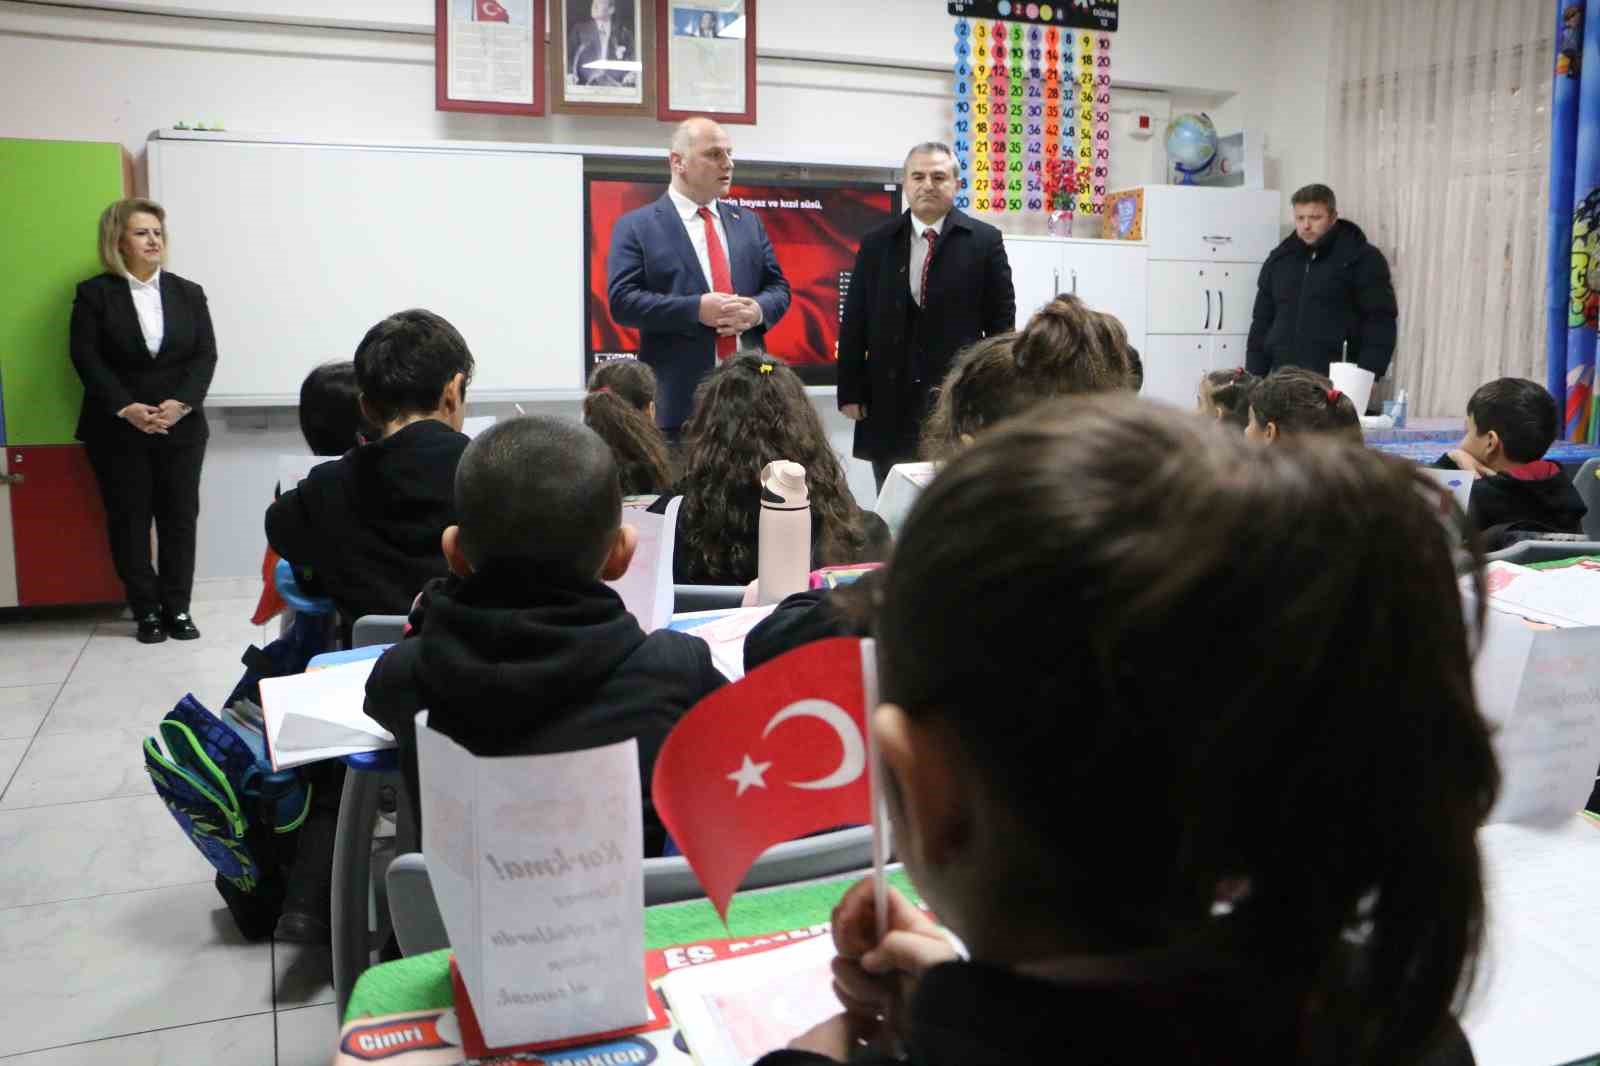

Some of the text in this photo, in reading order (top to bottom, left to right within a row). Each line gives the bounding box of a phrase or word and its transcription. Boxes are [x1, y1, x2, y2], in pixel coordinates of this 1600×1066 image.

[960, 25, 1109, 49] 2 3 4 5 6 7 8 9 10
[960, 45, 1110, 66] 4 6 8 10 12 14 16 18 20
[959, 65, 1110, 85] 6 9 12 15 18 21 24 27 30
[959, 83, 1109, 104] 8 12 16 20 24 28 32 36 40
[957, 102, 1109, 122] 10 15 20 25 30 35 40 45 50
[956, 121, 1110, 141] 12 18 24 30 36 42 48 54 60
[955, 141, 1109, 160] 14 21 28 35 42 49 56 63 70
[976, 160, 989, 172] 24
[992, 161, 1006, 172] 32
[1009, 161, 1023, 172] 40
[1028, 160, 1041, 172] 48
[1095, 166, 1108, 177] 80
[976, 179, 988, 191] 27
[992, 179, 1005, 191] 36
[1009, 180, 1021, 191] 45
[1027, 180, 1040, 192] 54
[1094, 185, 1106, 196] 90
[956, 197, 969, 208] 20
[976, 198, 989, 209] 30
[992, 198, 1006, 209] 40
[1009, 199, 1022, 210] 50
[1028, 198, 1041, 210] 60
[1080, 203, 1092, 213] 90
[359, 1027, 423, 1052] Cimri
